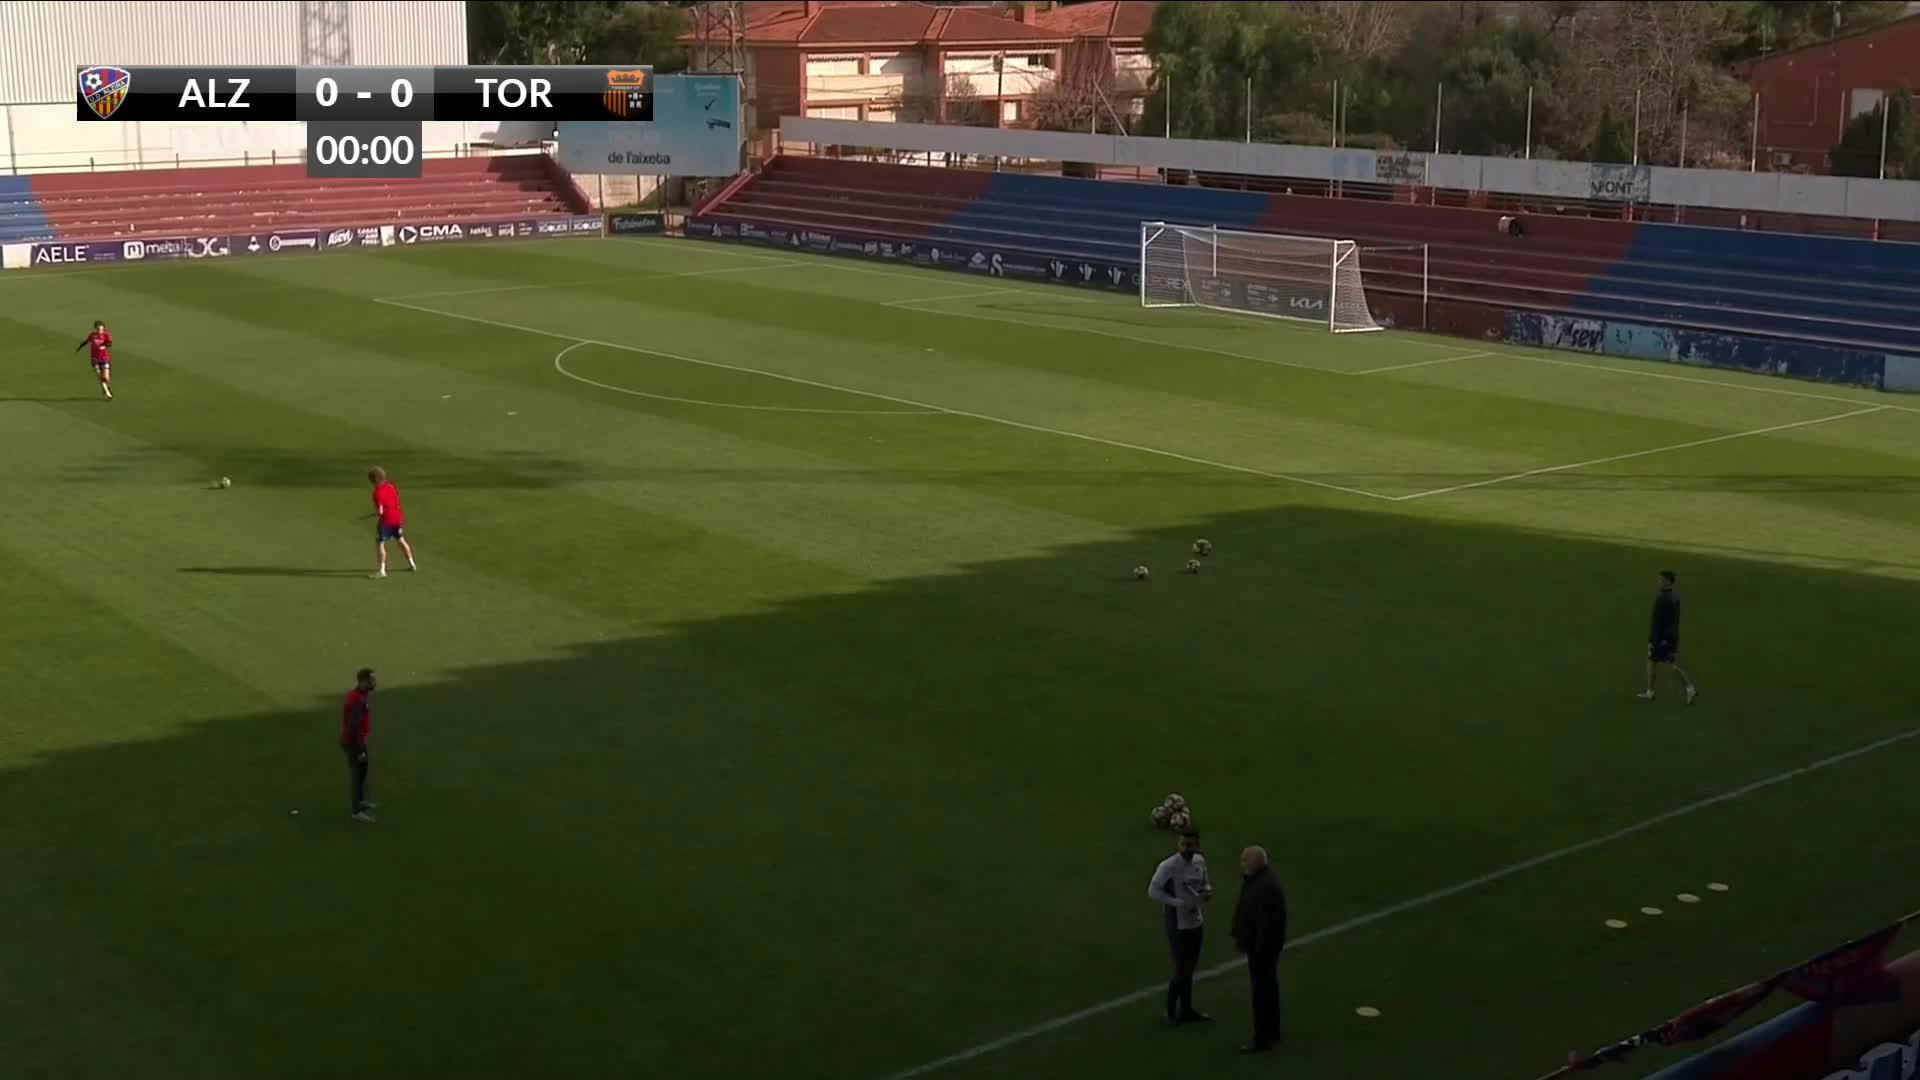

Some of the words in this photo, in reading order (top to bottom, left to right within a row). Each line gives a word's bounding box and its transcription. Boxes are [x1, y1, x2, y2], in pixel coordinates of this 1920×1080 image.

[607, 151, 623, 164] de
[626, 151, 671, 165] l'aixeta
[420, 224, 463, 237] CMA
[36, 245, 87, 263] AELE
